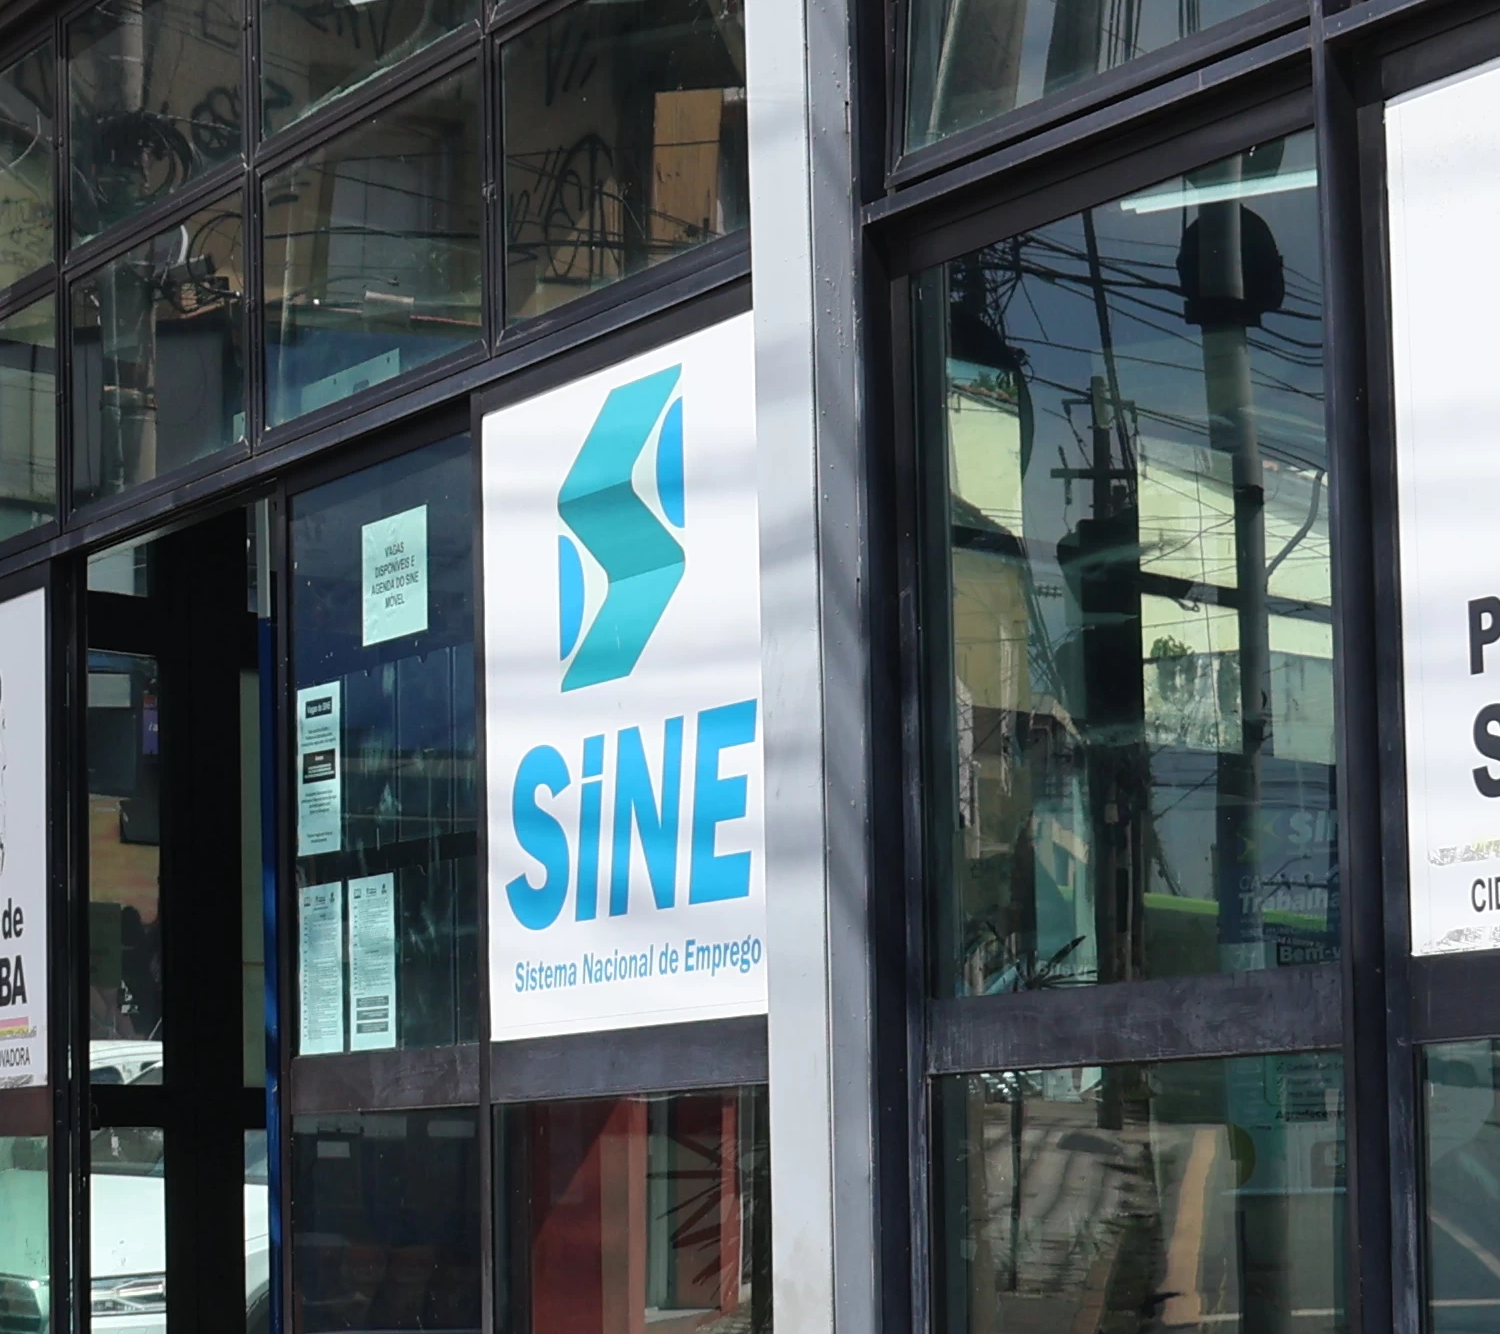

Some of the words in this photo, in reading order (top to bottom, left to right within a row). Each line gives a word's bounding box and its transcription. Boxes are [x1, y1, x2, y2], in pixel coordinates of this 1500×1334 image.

[1, 897, 24, 939] de
[515, 957, 577, 993] Sistema
[582, 945, 653, 985] Nacional
[660, 941, 679, 976] de
[684, 934, 762, 979] Emprego
